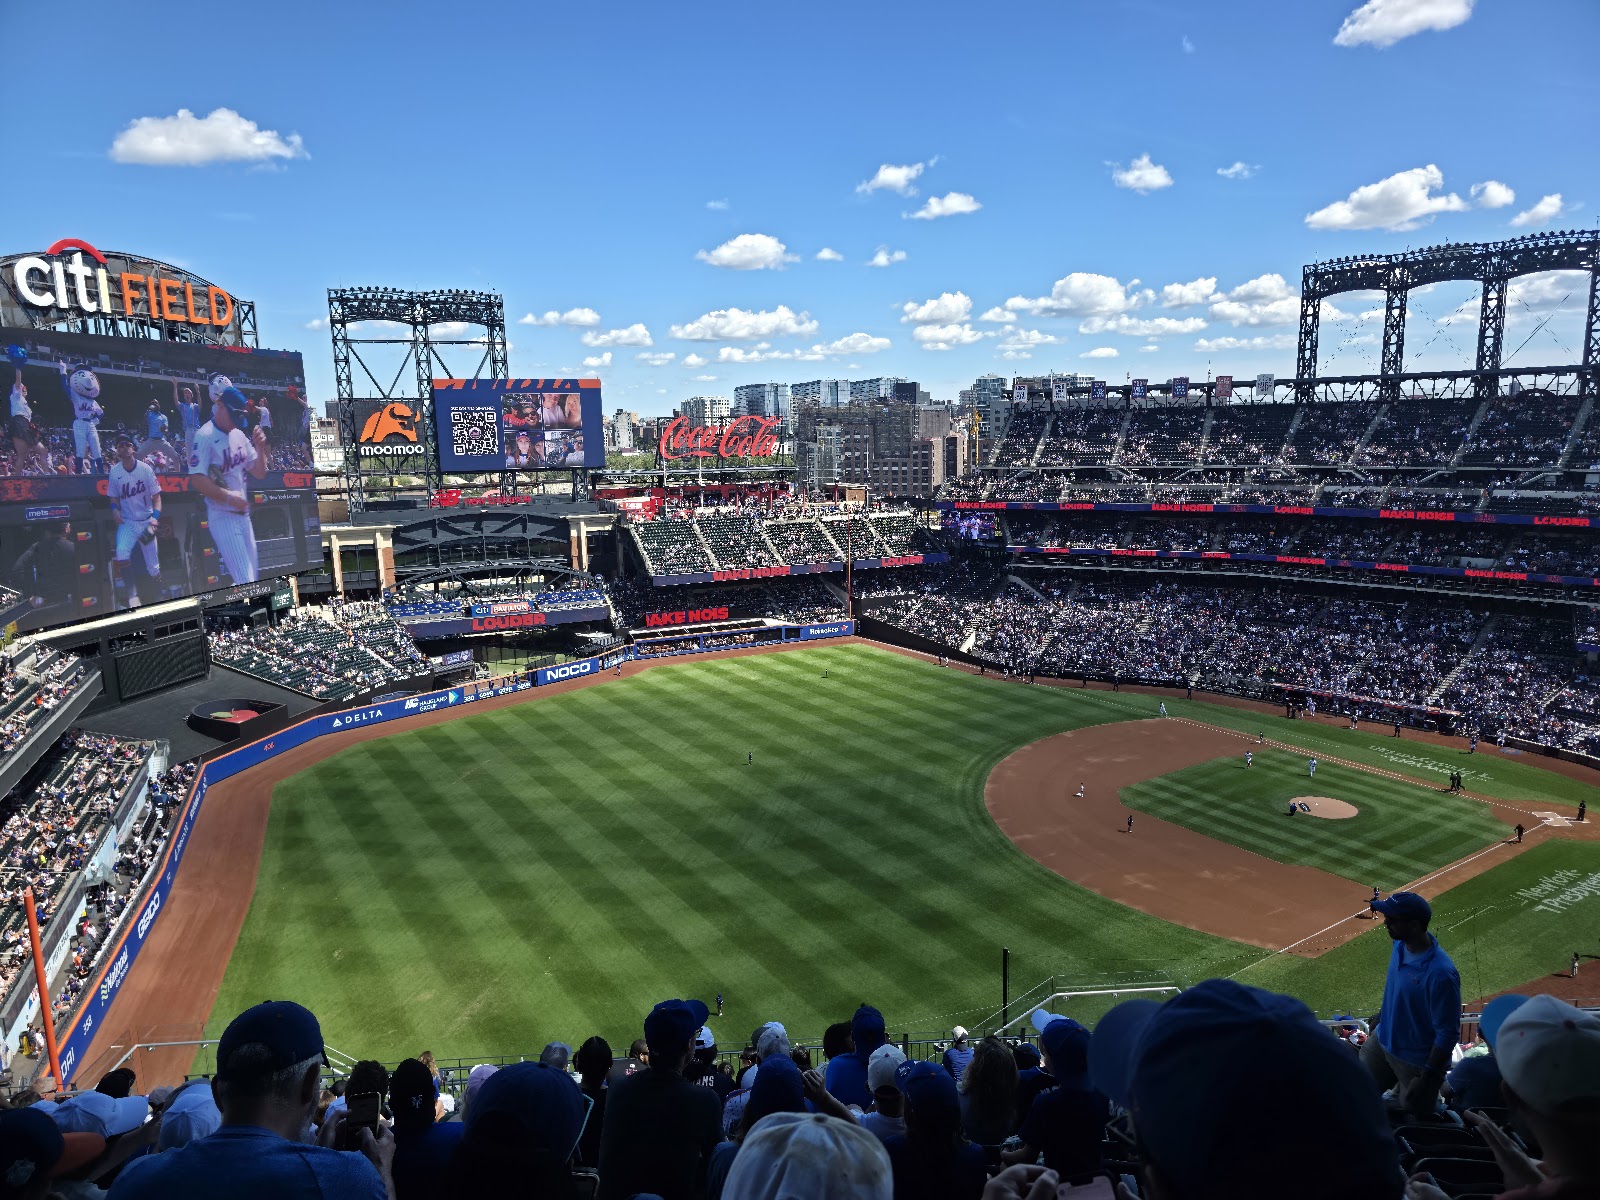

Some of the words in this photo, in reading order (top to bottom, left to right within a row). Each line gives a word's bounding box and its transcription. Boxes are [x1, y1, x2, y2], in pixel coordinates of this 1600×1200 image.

[120, 271, 233, 326] FIELD
[659, 415, 783, 460] Coca-Cola
[360, 444, 425, 456] moomoo
[283, 472, 313, 487] GET
[121, 480, 146, 500] Mets
[28, 509, 67, 517] mets.com
[1151, 504, 1180, 512] MAKE
[1182, 504, 1214, 512] NOISE
[1274, 505, 1313, 515] LOUDER
[1380, 509, 1414, 519] MAKE
[1416, 511, 1454, 521] NOISE
[1534, 516, 1590, 527] LOUDER
[881, 555, 923, 567] LOUDER
[713, 568, 750, 581] MAKE
[751, 566, 790, 578] NOISE
[1465, 569, 1493, 578] MAKE
[1495, 571, 1527, 581] NOISE
[475, 606, 489, 614] citi
[493, 604, 527, 613] PAVILION
[473, 613, 546, 631] LOUDER
[546, 662, 591, 680] NOCO
[345, 709, 383, 724] DELTA
[137, 891, 160, 940] GEICO
